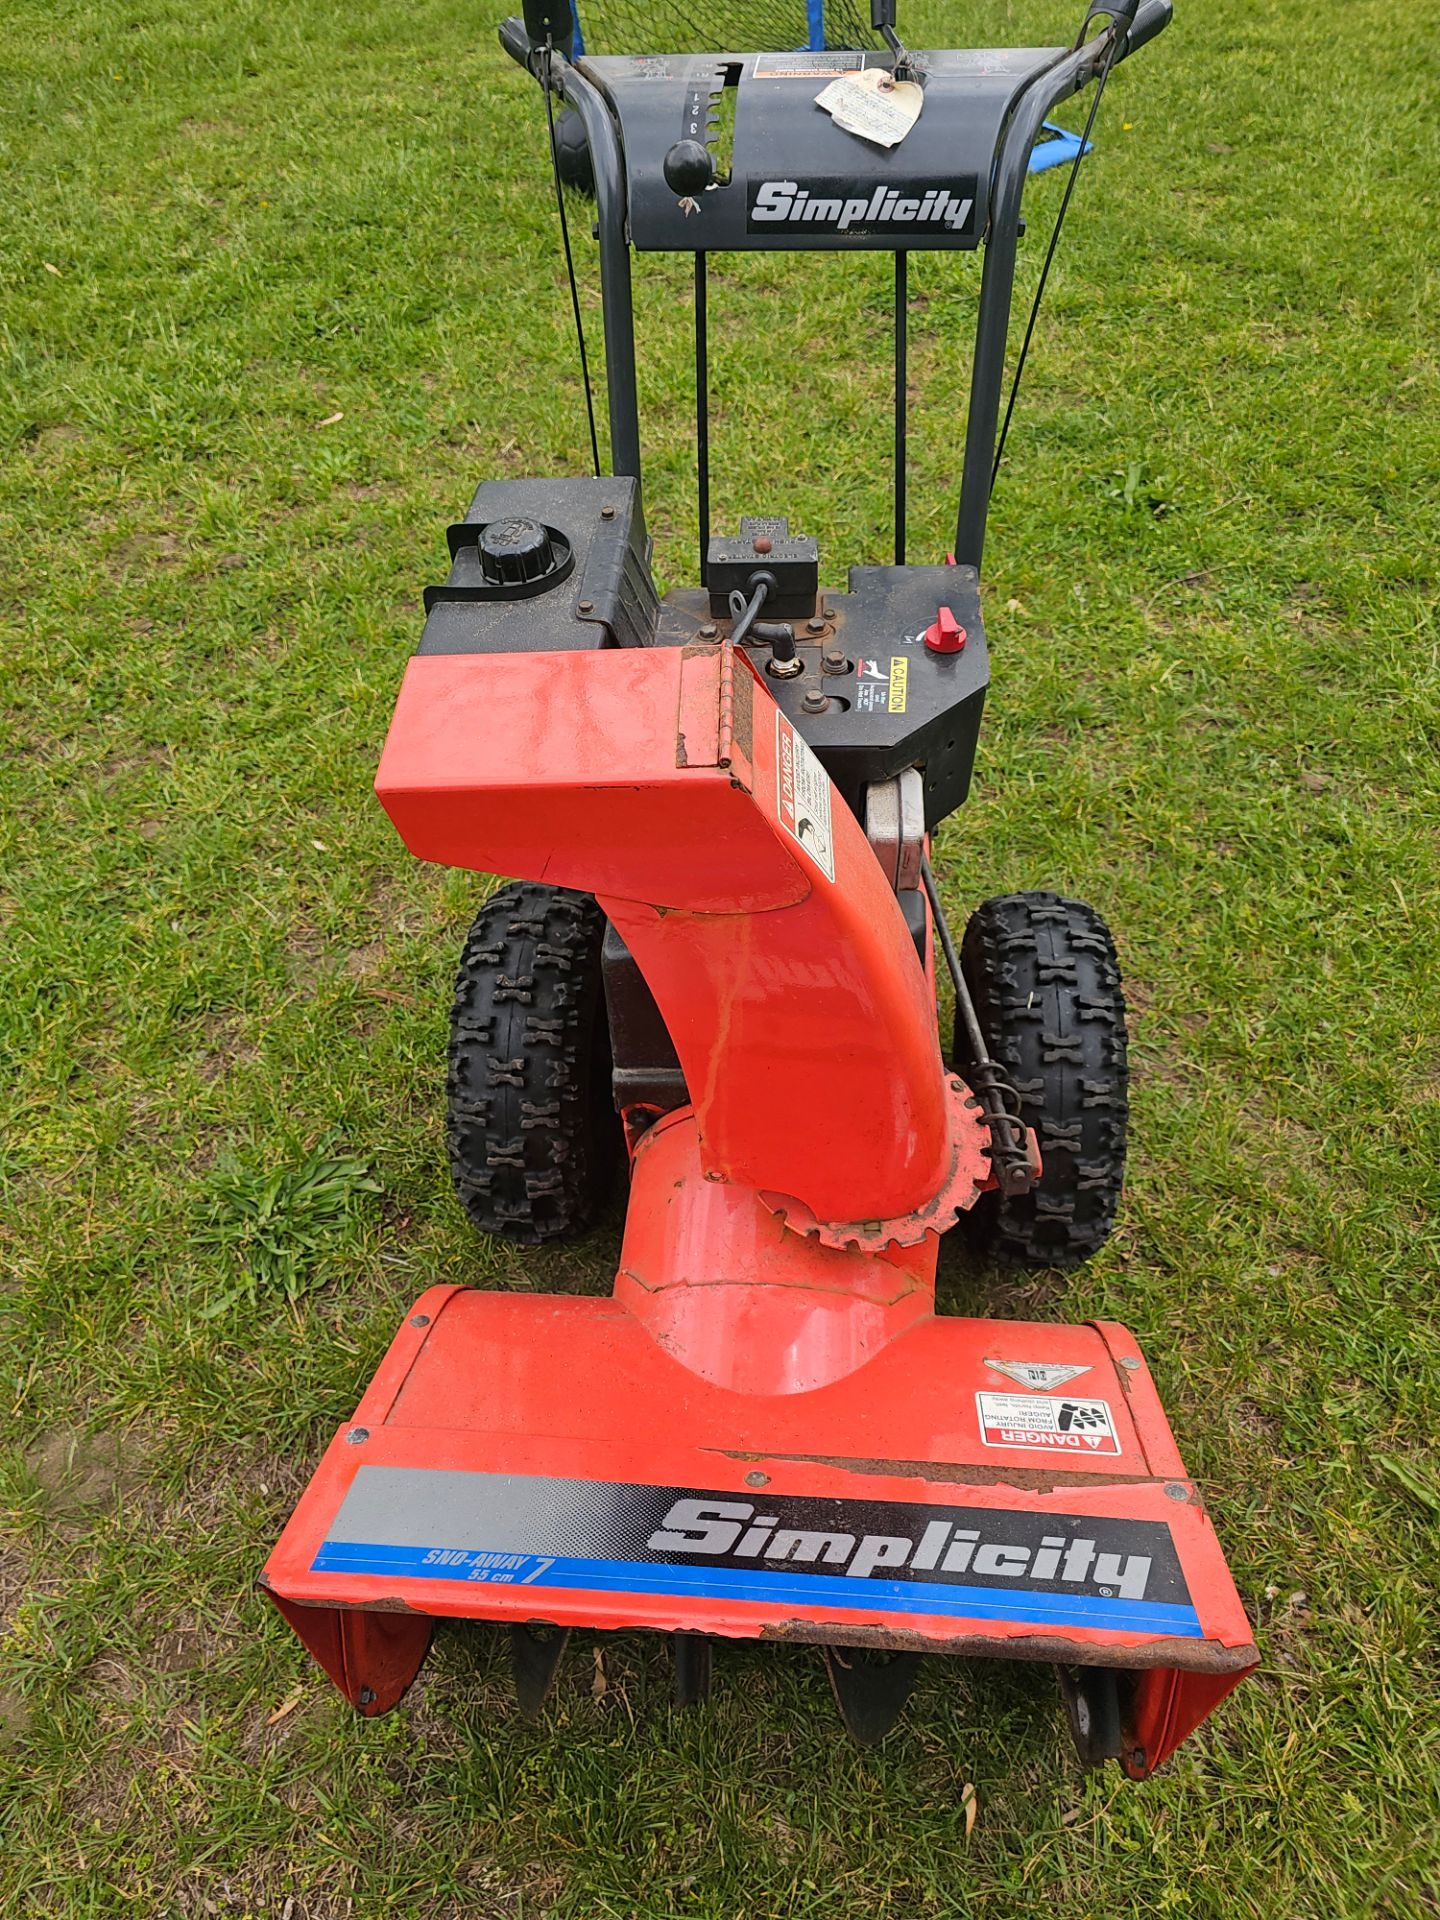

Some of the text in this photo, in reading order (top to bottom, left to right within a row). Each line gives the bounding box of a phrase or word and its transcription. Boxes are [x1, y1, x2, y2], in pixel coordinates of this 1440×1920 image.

[693, 92, 701, 102] 1
[692, 105, 700, 116] 2
[690, 123, 698, 134] 3
[751, 181, 974, 230] Simplicity
[891, 668, 905, 711] CAUTION
[782, 732, 793, 800] DANGER
[984, 1414, 1026, 1422] ROTATING
[1018, 1410, 1051, 1418] AUGER!
[996, 1421, 1027, 1429] INJURY
[1000, 1430, 1080, 1446] DANGER
[647, 1498, 1153, 1600] Simplicity
[422, 1549, 556, 1584] SNO-AWAY 7
[467, 1568, 515, 1582] 55 cm
